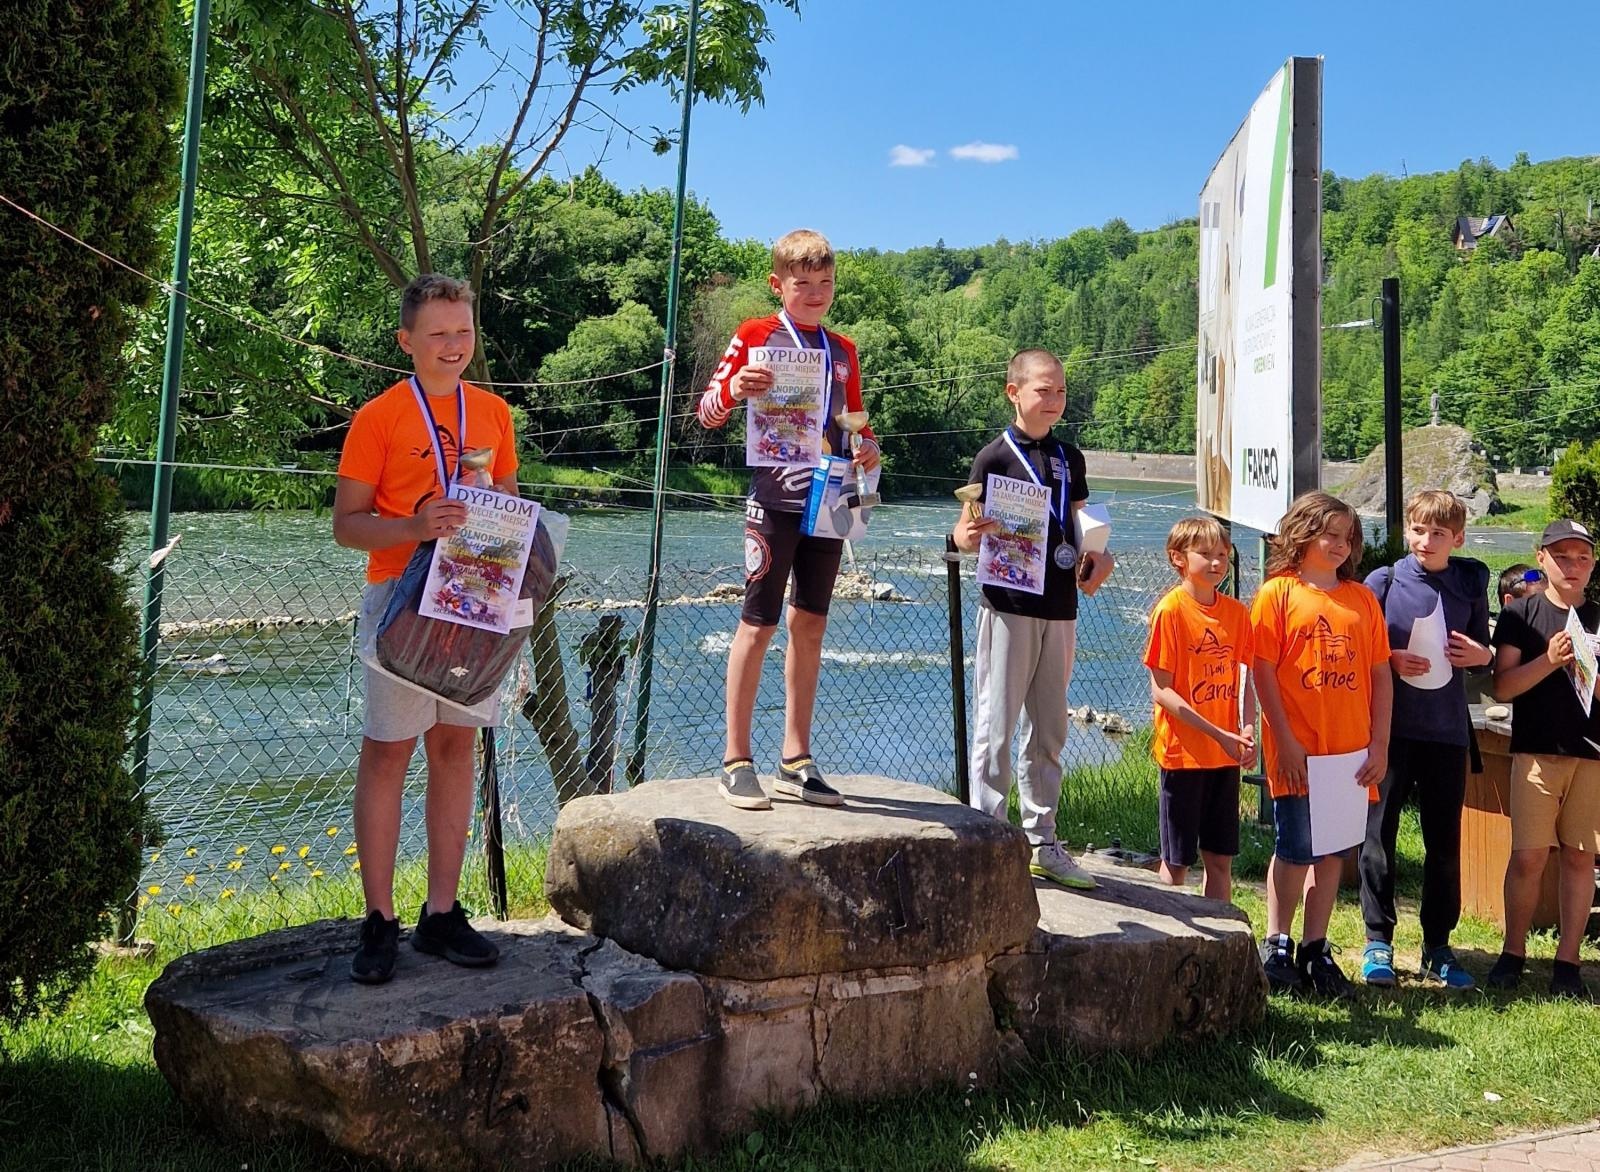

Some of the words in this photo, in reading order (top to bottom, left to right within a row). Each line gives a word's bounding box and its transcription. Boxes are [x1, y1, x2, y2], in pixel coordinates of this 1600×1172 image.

[755, 350, 821, 364] DYPLOM
[1248, 447, 1279, 490] FAKRO
[993, 477, 1047, 500] DYPLOM
[456, 488, 534, 517] DYPLOM
[500, 512, 529, 527] MIEJSCA
[1302, 666, 1360, 690] Canoe
